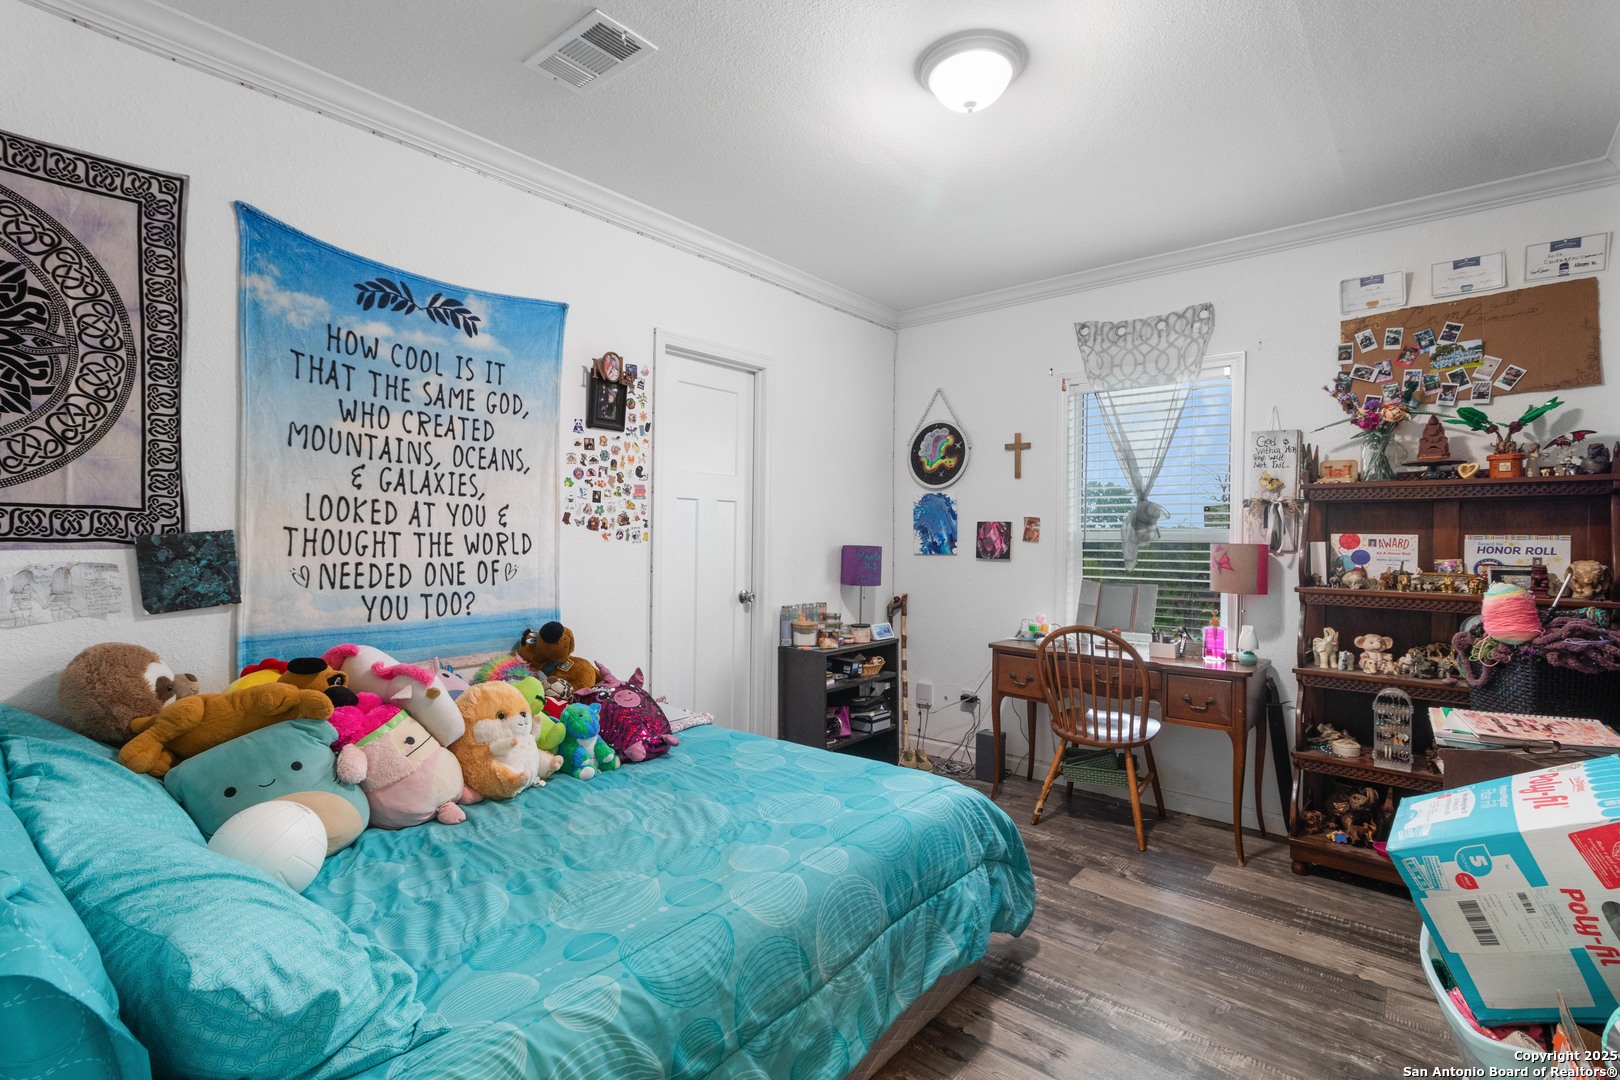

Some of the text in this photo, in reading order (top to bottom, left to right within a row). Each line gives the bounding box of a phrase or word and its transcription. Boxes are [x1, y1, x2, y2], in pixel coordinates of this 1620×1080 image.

[327, 324, 505, 385] HOW COOL IS IT
[290, 349, 529, 420] THAT THE SAME GOD,
[338, 399, 494, 442] WHO CREATED
[288, 421, 531, 475] MOUNTAINS, OCEANS,
[1256, 436, 1277, 447] God
[351, 464, 486, 500] & GALAXIES,
[306, 493, 509, 528] LOOKED AT YOU &
[283, 526, 532, 559] THOUGHT THE WORLD
[1378, 537, 1410, 549] AWARD
[1477, 546, 1557, 555] HONOR ROLL
[319, 560, 500, 590] NEEDED ONE OF
[361, 591, 476, 622] YOU TOO?
[1468, 855, 1488, 867] 5
